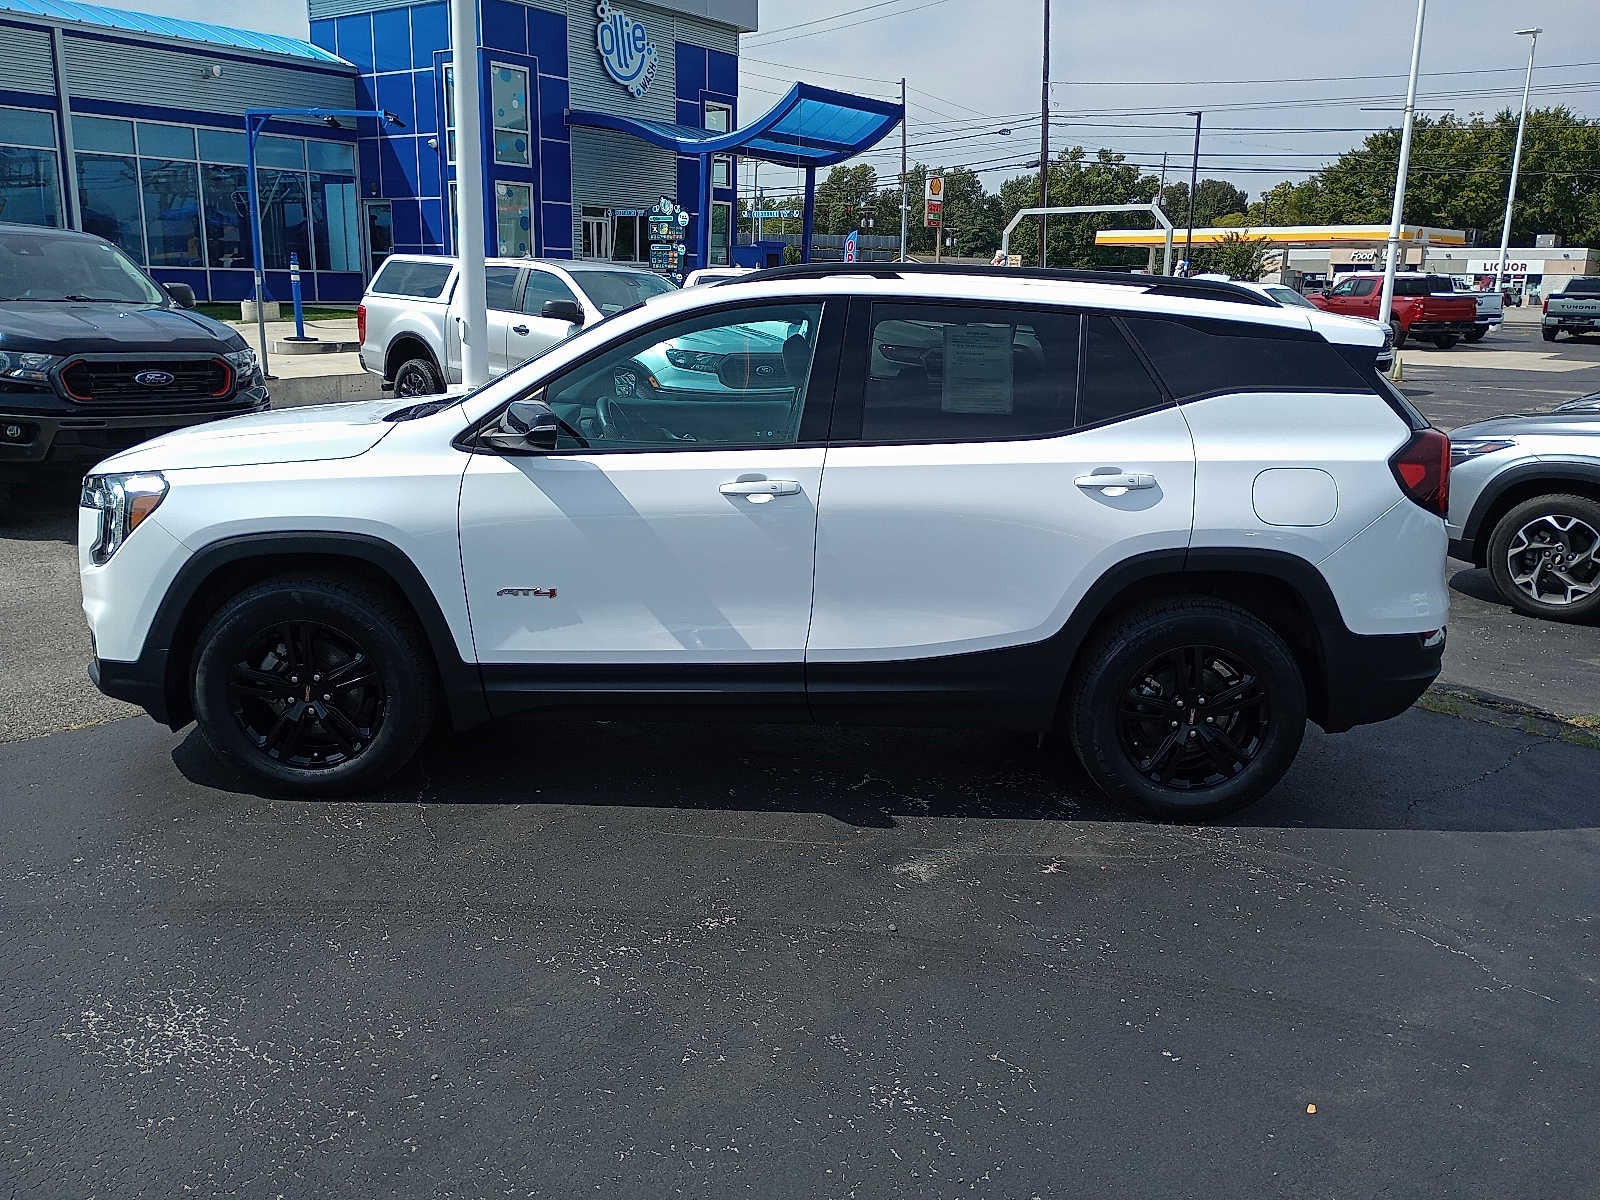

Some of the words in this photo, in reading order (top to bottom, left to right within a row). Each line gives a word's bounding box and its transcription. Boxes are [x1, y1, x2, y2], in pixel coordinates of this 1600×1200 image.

[601, 14, 646, 69] ollie
[640, 61, 657, 91] WASH
[1350, 250, 1375, 260] Food
[497, 586, 557, 598] AT4
